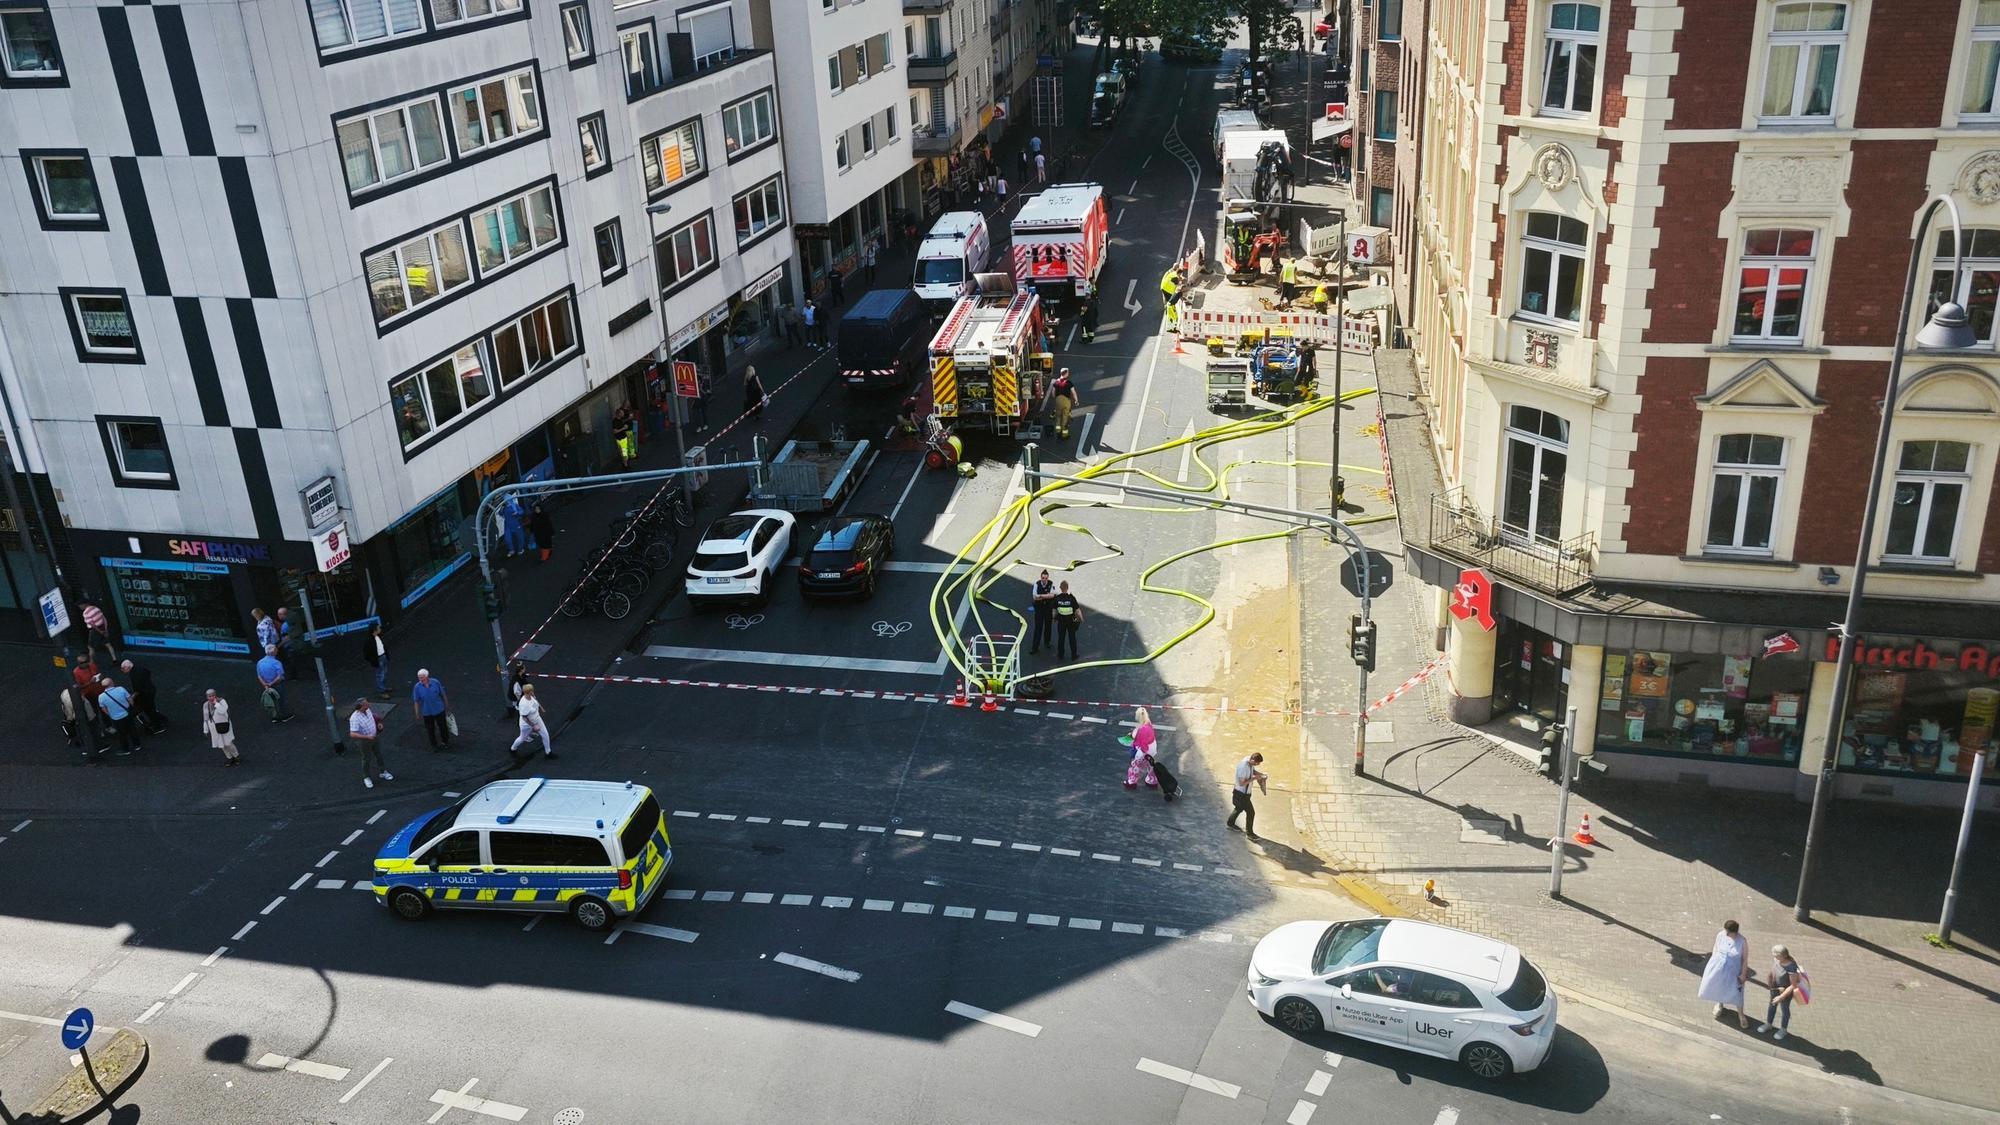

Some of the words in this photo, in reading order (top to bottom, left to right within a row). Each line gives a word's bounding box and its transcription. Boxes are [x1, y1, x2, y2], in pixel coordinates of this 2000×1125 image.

[169, 540, 270, 559] SAFIPHONE
[325, 551, 344, 569] KIOSK
[1639, 680, 1658, 691] 3€
[441, 875, 478, 885] POLIZEI
[1342, 1006, 1360, 1015] Nutze
[1372, 1012, 1388, 1021] Uber
[1389, 1016, 1404, 1025] App
[1342, 1013, 1357, 1021] auch
[1364, 1016, 1378, 1025] Köln
[1415, 1021, 1454, 1039] Uber
